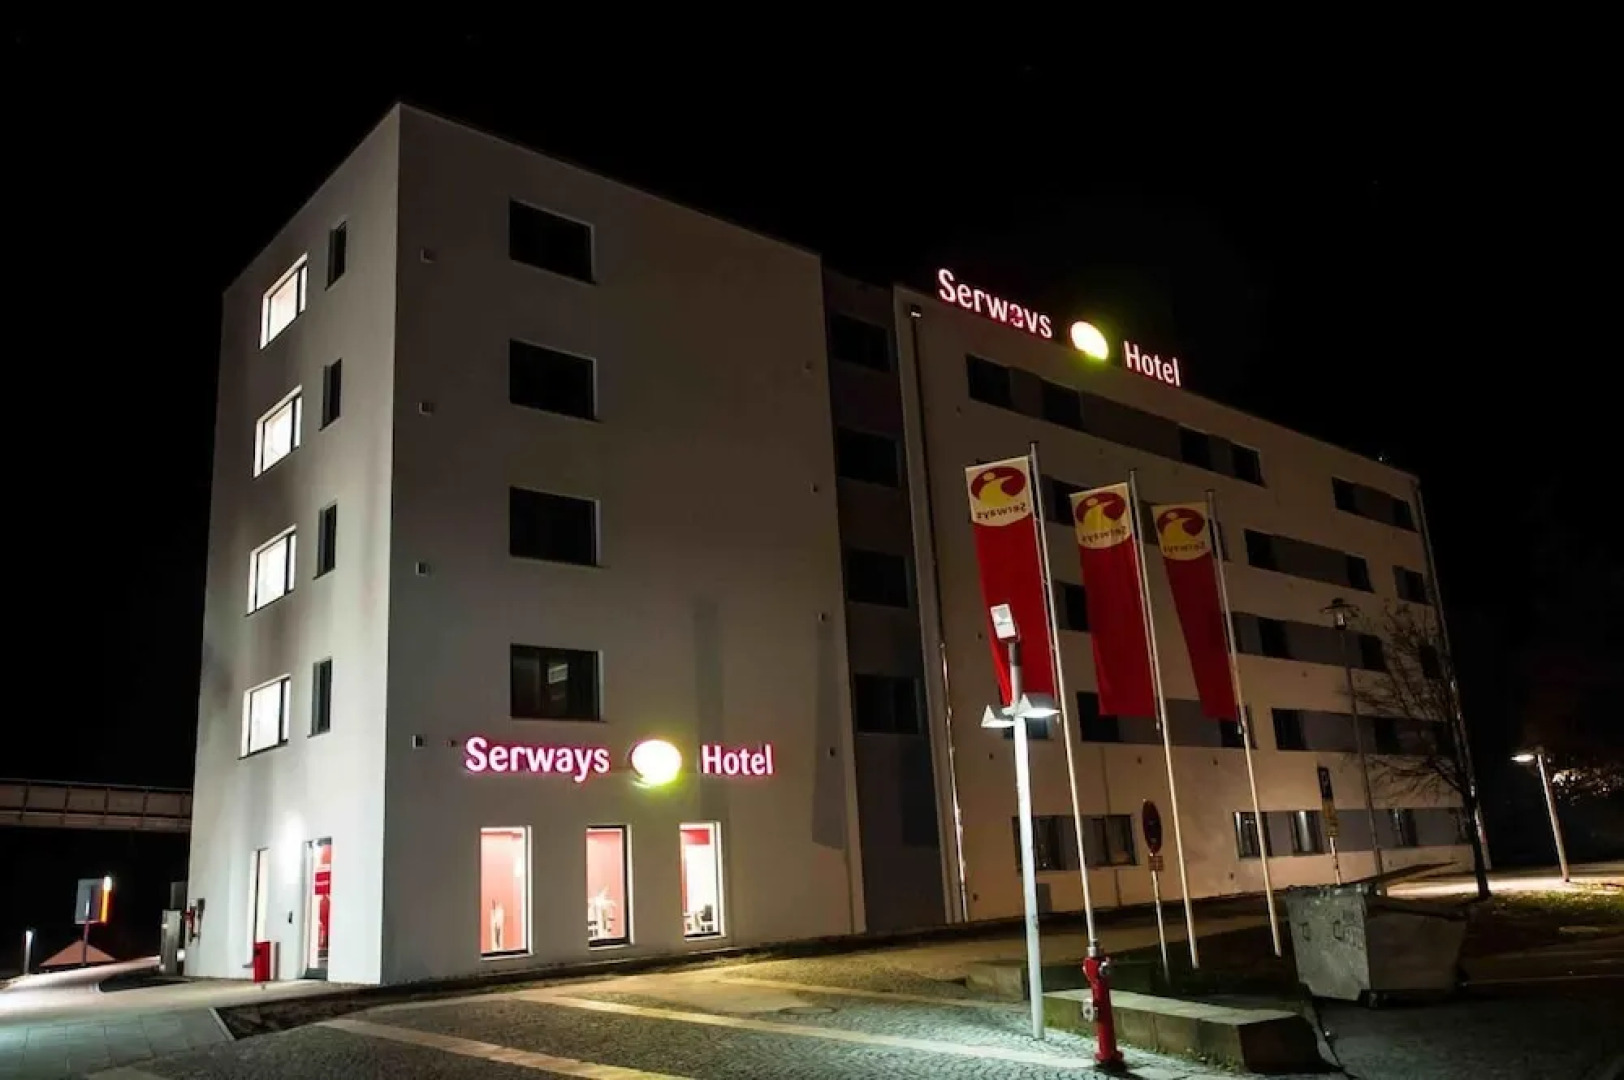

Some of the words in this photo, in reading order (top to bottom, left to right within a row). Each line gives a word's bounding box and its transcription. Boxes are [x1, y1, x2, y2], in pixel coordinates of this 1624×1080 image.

[1123, 340, 1181, 387] Hotel
[465, 736, 611, 783] Serways
[701, 743, 774, 775] Hotel
